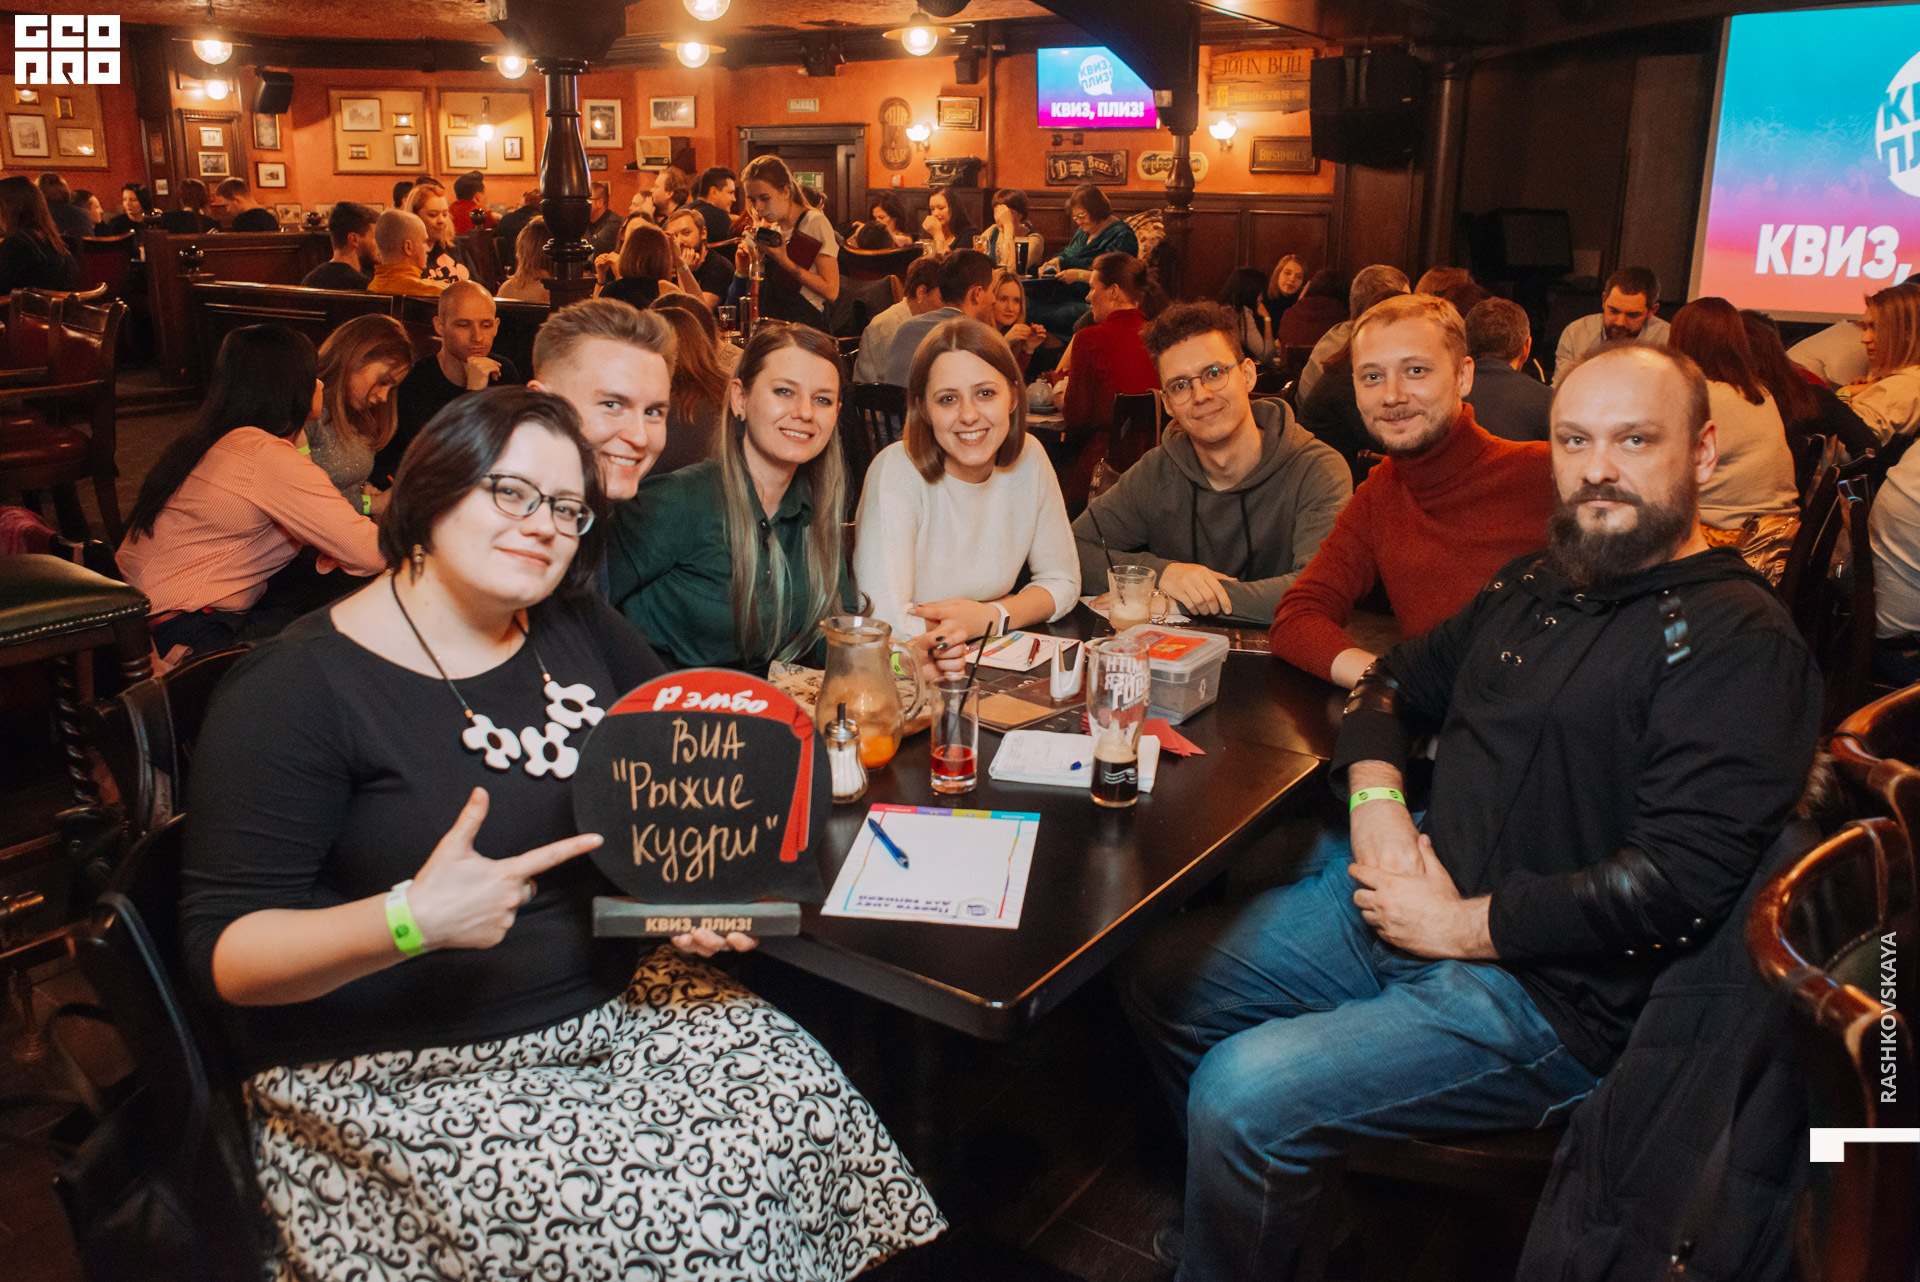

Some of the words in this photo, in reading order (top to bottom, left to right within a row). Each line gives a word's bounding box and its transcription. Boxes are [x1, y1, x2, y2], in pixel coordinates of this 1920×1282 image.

[1267, 56, 1304, 74] BULL
[1051, 102, 1096, 120] КВИЗ,
[1097, 101, 1145, 118] ПЛИЗ!
[1755, 224, 1912, 287] КВИЗ,
[652, 685, 769, 714] Рэмбо
[671, 717, 746, 765] ВИА
[645, 917, 697, 934] КВИЗ,
[701, 917, 753, 931] ПЛИЗ!
